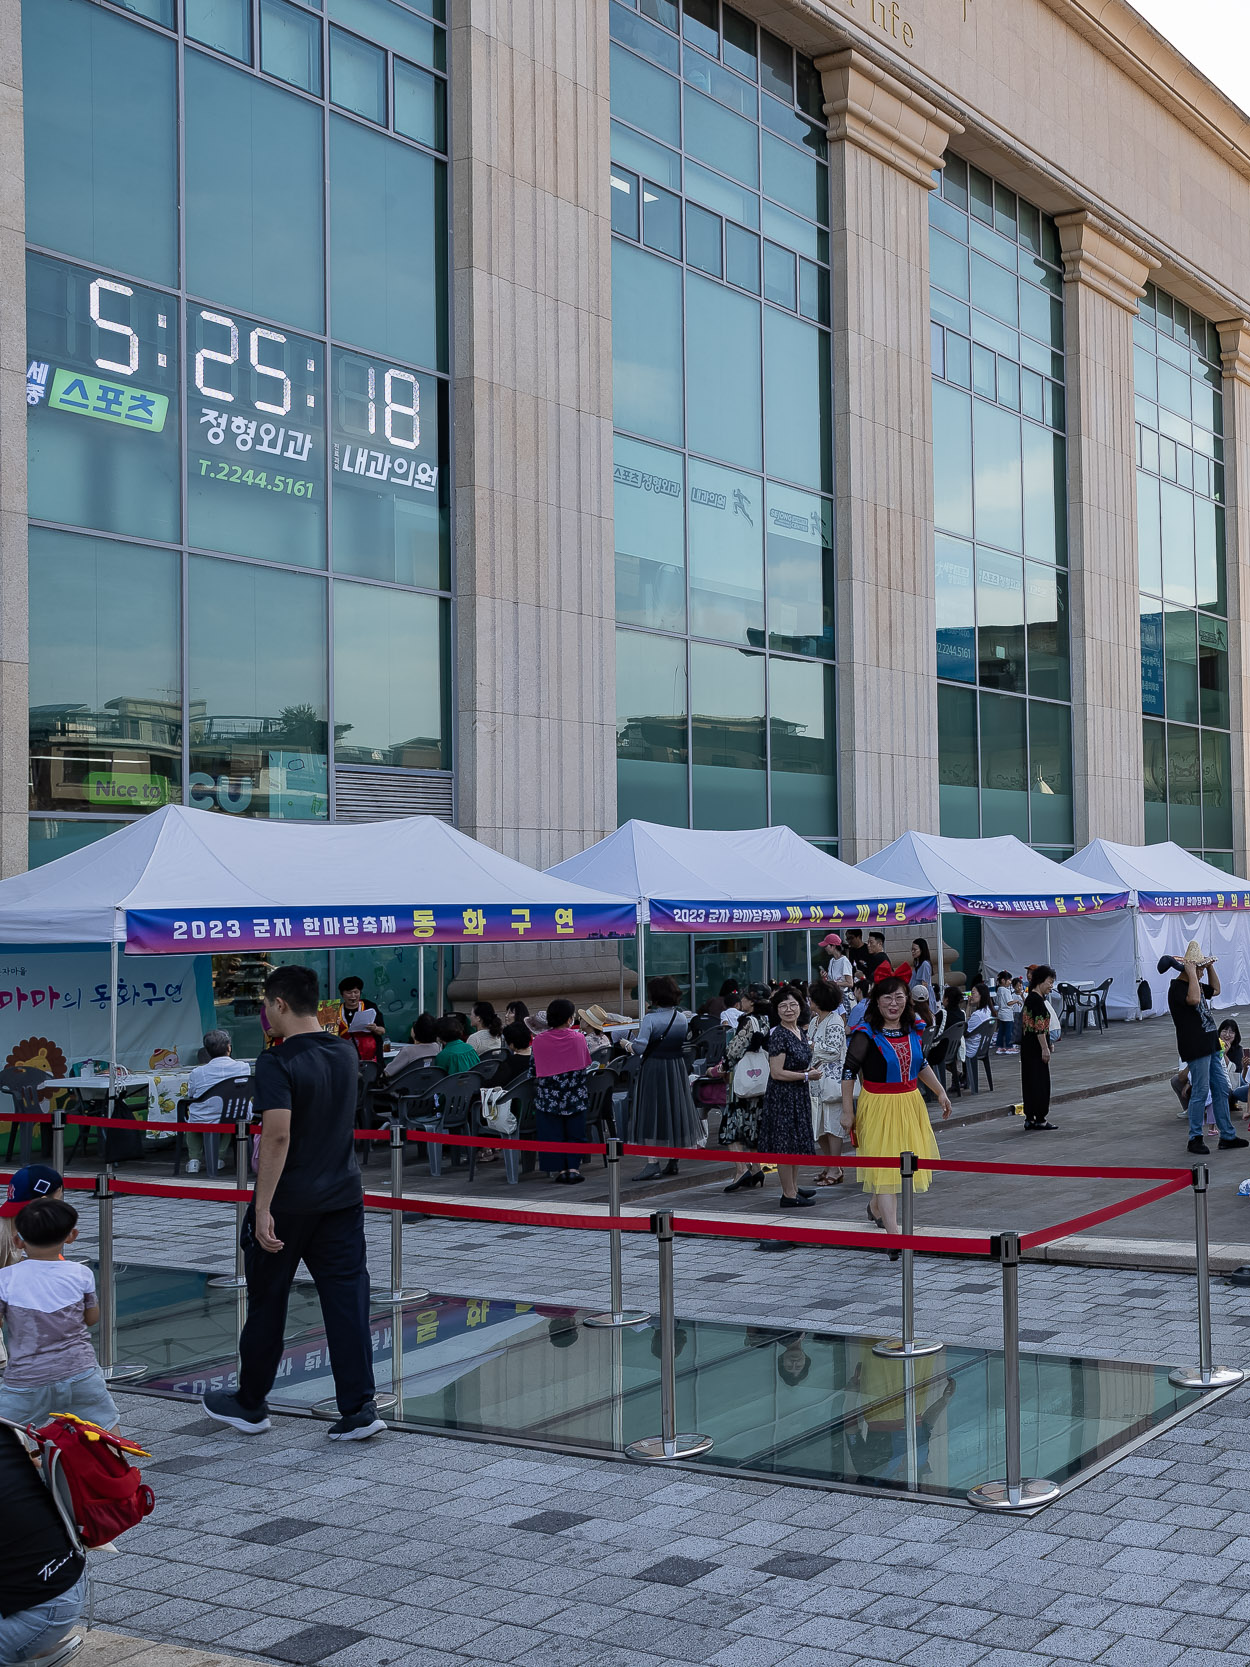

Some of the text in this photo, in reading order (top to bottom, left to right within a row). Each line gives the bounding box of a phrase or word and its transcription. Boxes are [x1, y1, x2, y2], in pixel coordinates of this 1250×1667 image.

[59, 378, 154, 425] 스포츠
[199, 407, 314, 462] 정형외과
[199, 459, 314, 498] T.2244.5161
[341, 444, 438, 492] 내과의원
[614, 467, 640, 485] 스포츠
[642, 472, 681, 498] 정형외과
[96, 780, 161, 800] Nice to
[189, 771, 253, 812] CU
[673, 908, 705, 923] 2023
[708, 908, 730, 924] 군자
[732, 908, 782, 924] 한마당축제
[967, 899, 994, 910] 2023
[1154, 896, 1171, 906] 2023
[173, 921, 242, 941] 2023
[253, 919, 292, 938] 군자
[303, 915, 398, 936] 한마당축제
